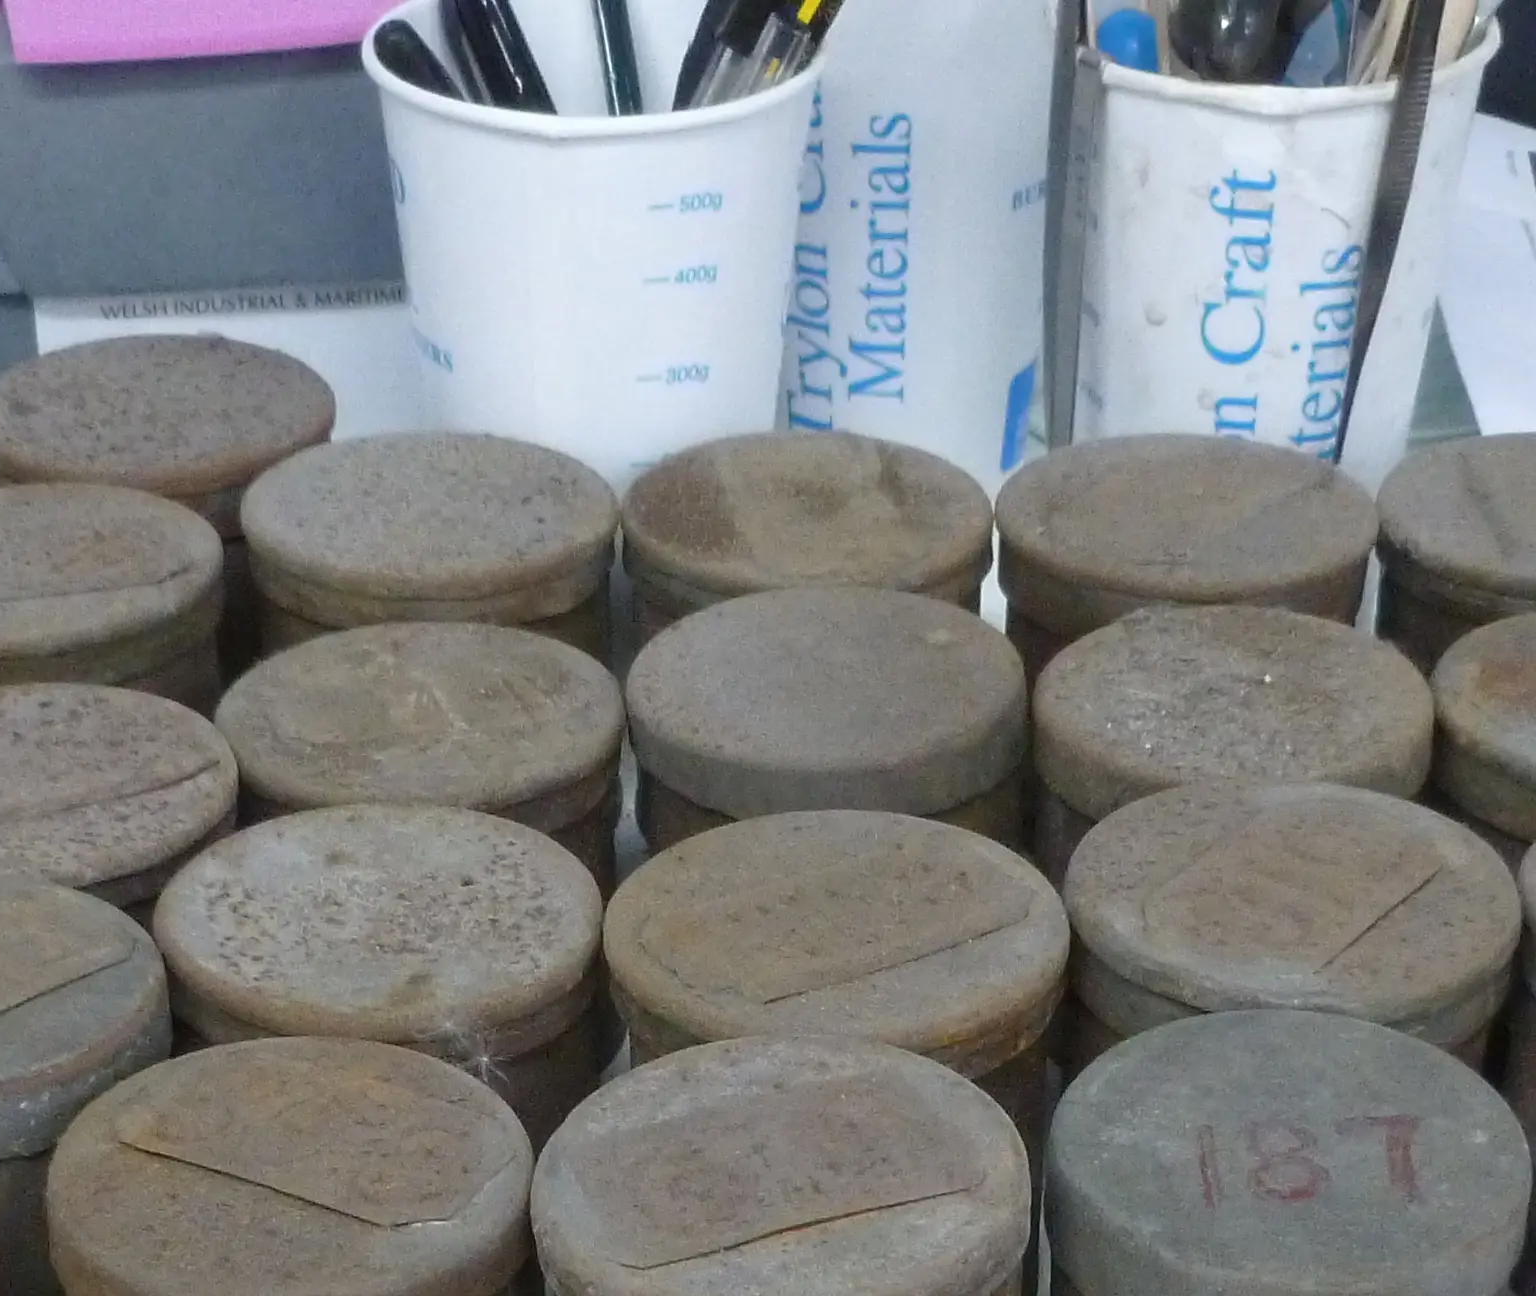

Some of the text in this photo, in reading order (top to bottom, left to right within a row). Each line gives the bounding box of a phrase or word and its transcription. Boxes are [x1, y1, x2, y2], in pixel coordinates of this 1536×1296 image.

[679, 192, 723, 213] 500g
[99, 300, 167, 320] WELSH
[173, 293, 287, 316] INDUSTRIAL
[296, 293, 307, 308] &
[674, 265, 718, 284] 400g
[847, 112, 912, 403] Materials
[1200, 168, 1277, 366] Craft
[666, 364, 710, 386] 300g
[786, 241, 848, 431] Trylon
[1289, 242, 1363, 460] terials
